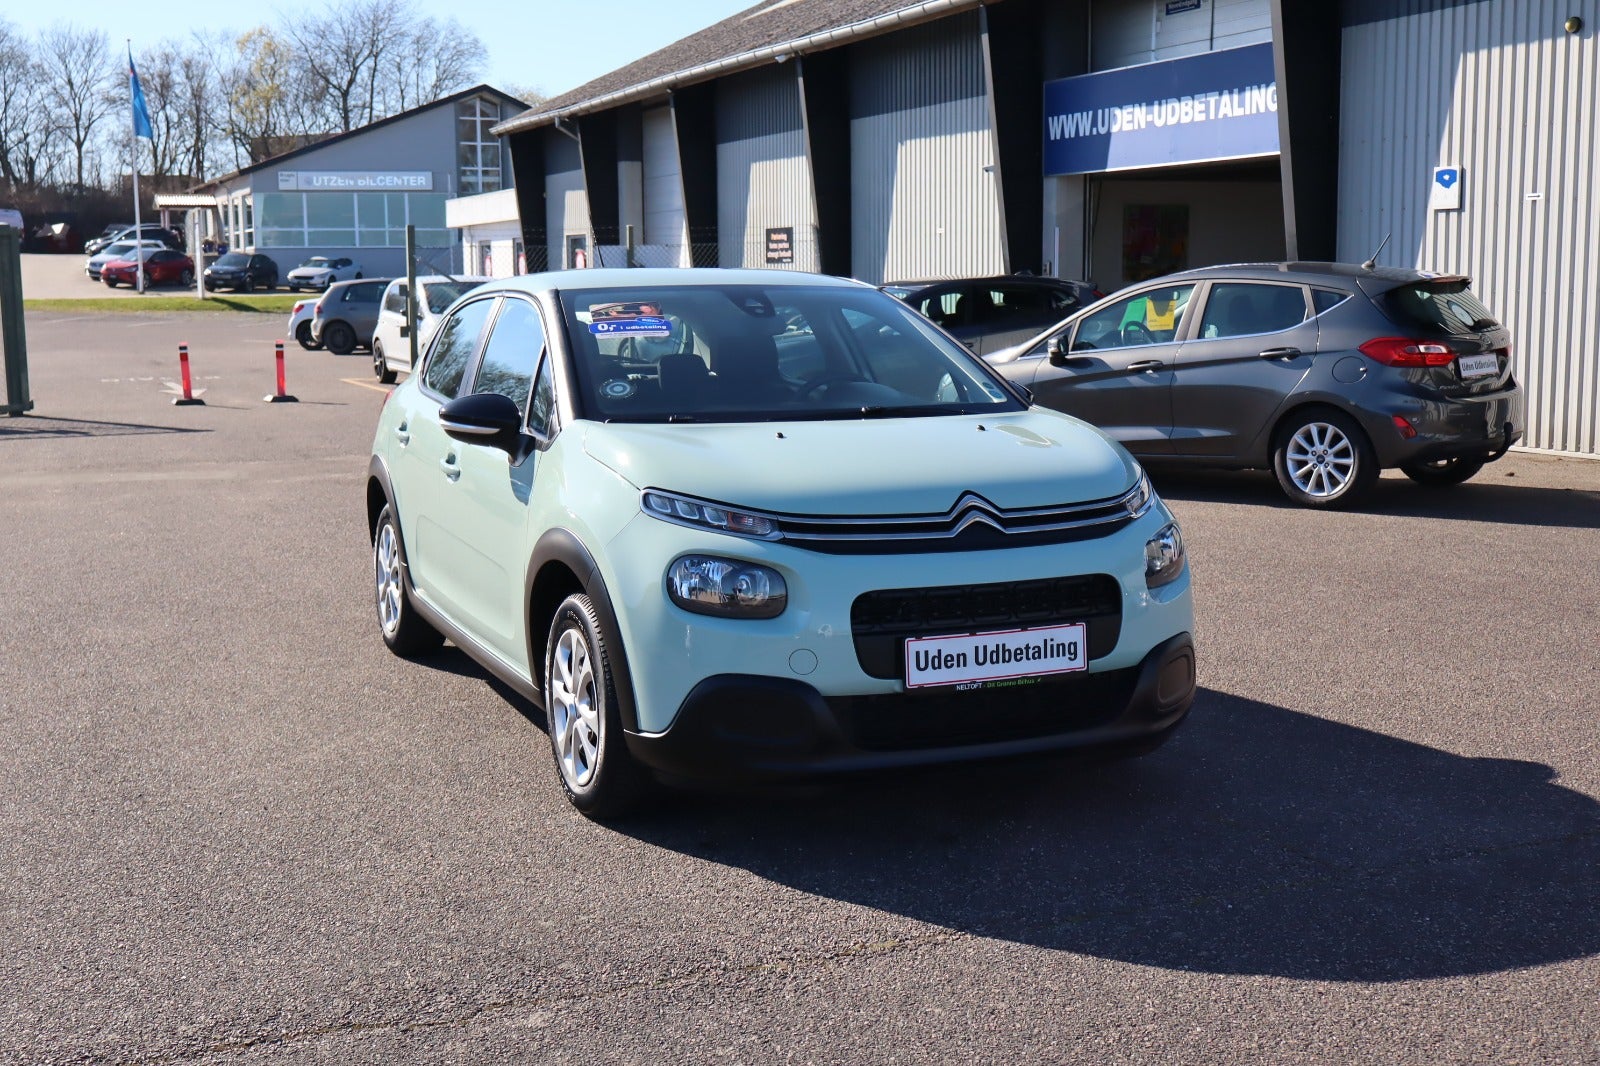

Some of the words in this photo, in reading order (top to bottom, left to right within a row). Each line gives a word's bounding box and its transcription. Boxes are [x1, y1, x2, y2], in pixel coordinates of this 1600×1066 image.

[915, 649, 967, 672] Uden
[974, 638, 1078, 667] Udbetaling
[956, 683, 982, 691] NELTOFT
